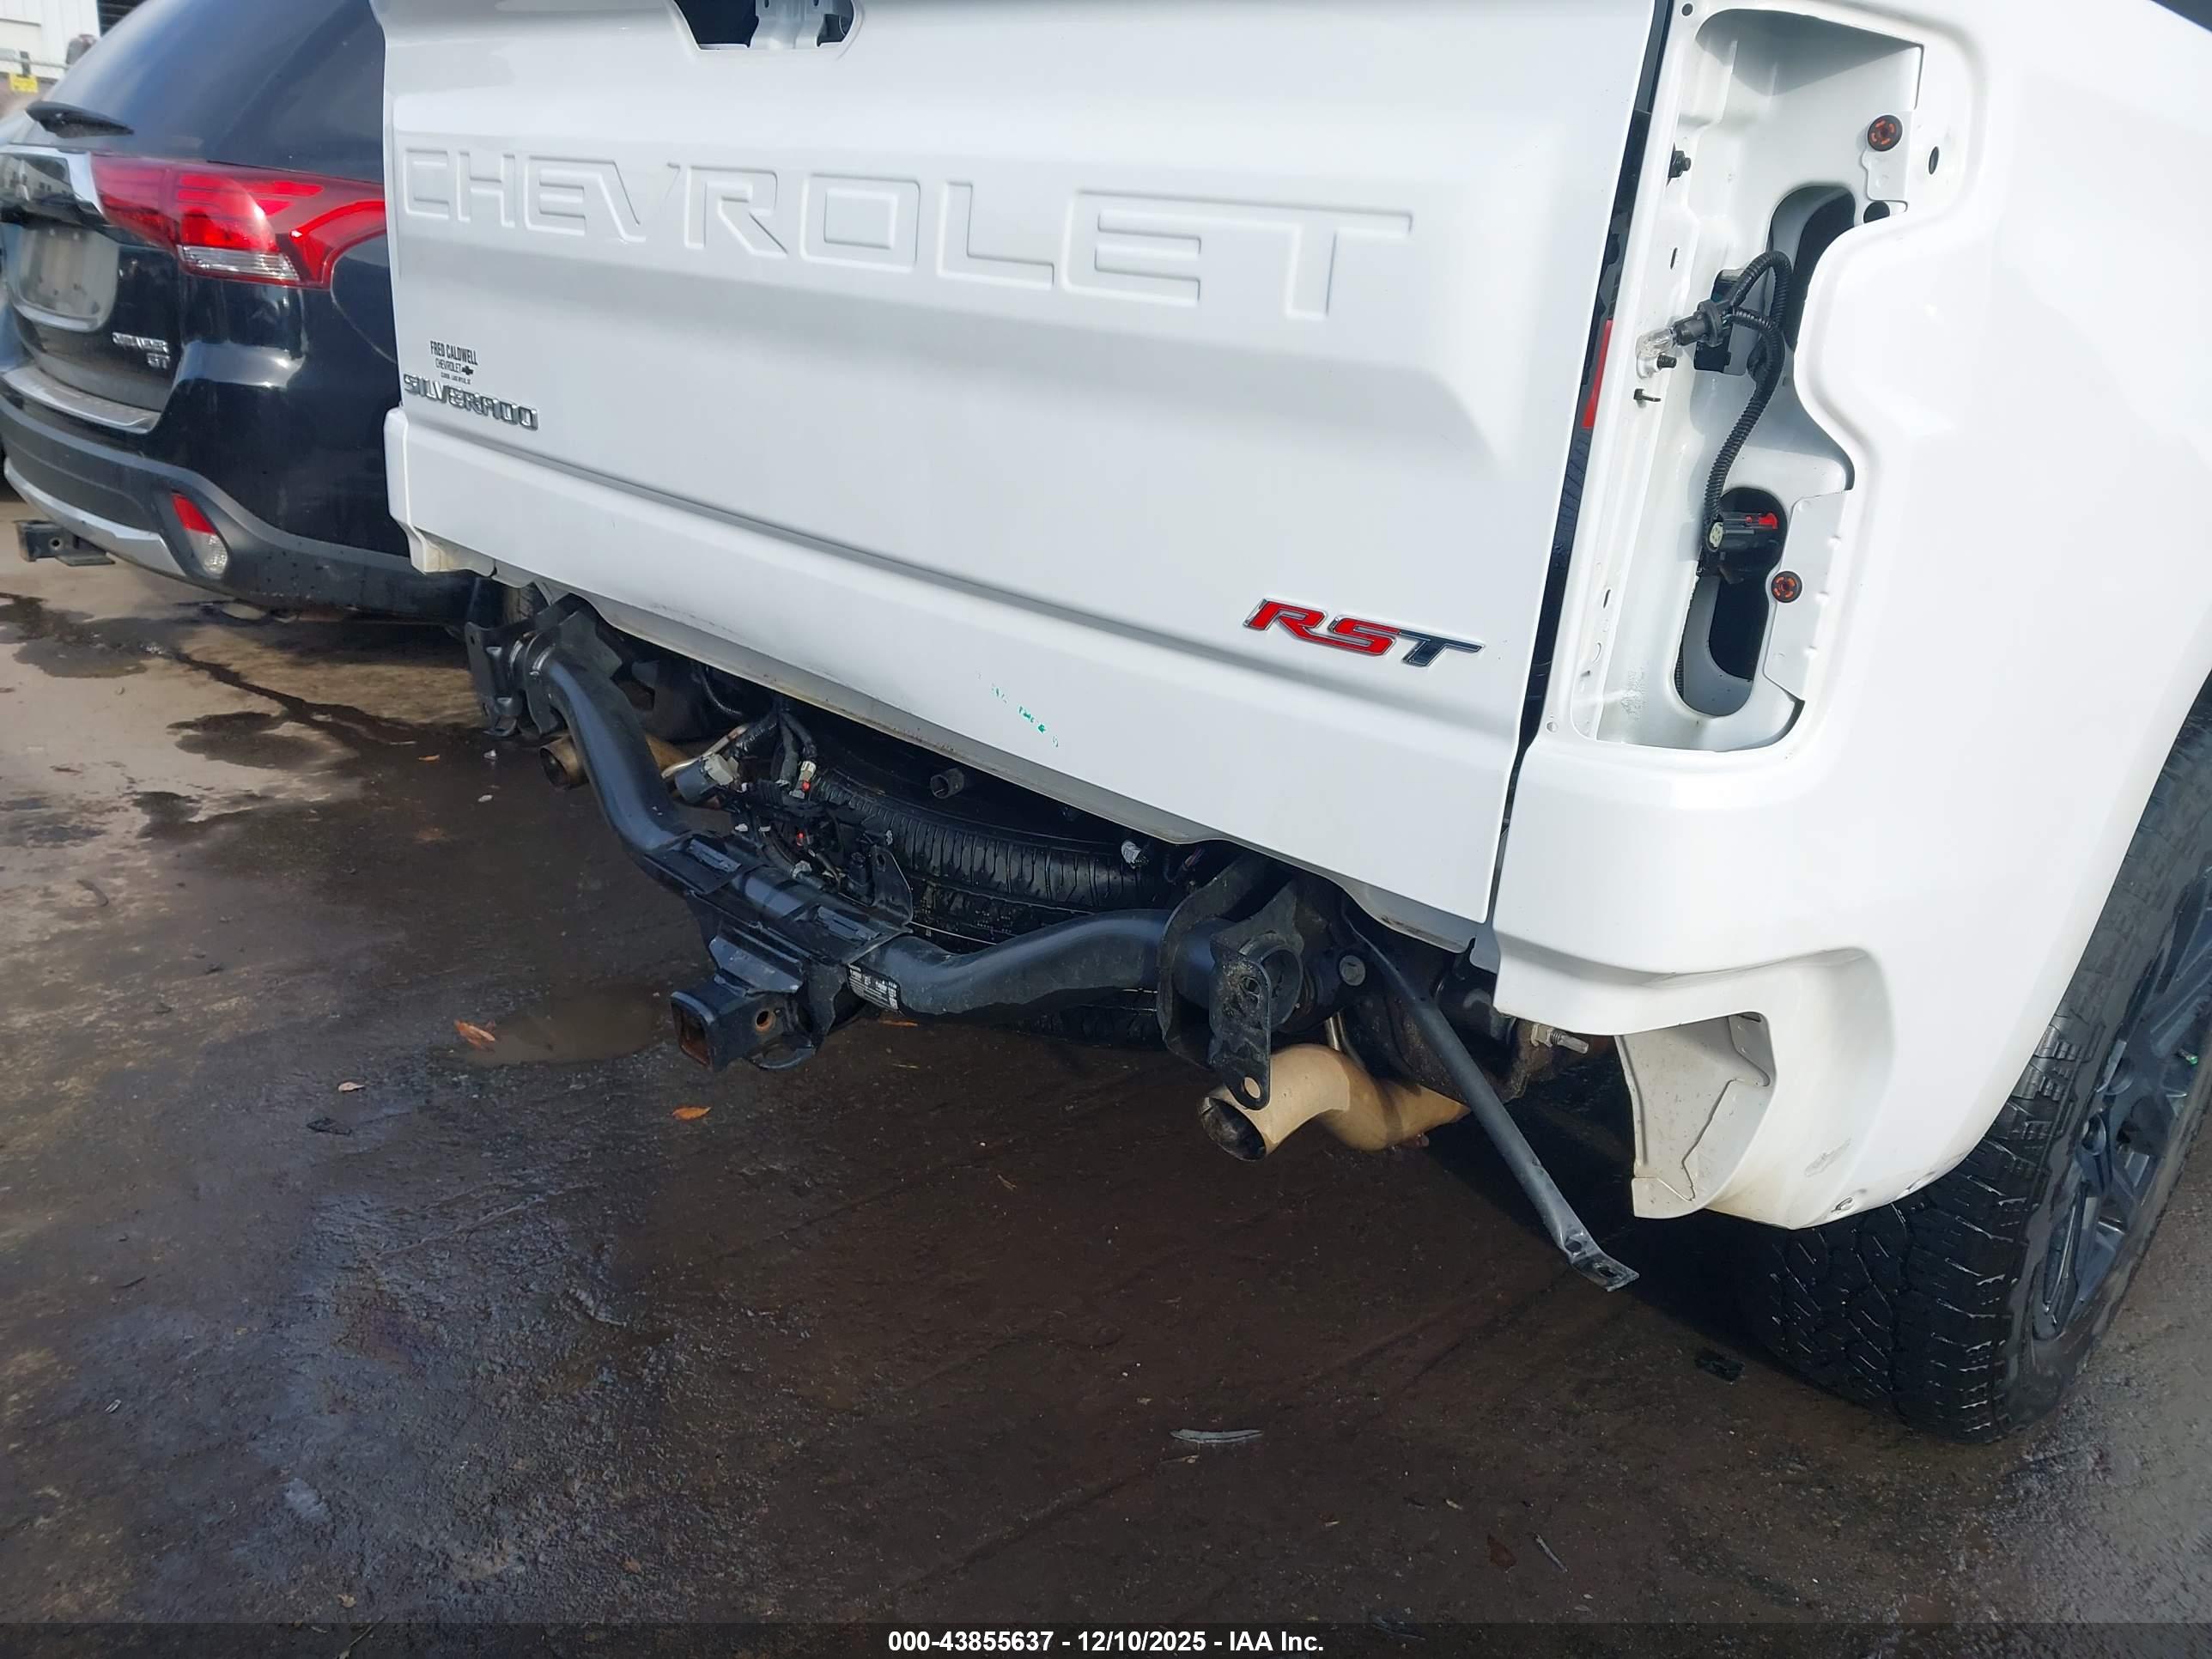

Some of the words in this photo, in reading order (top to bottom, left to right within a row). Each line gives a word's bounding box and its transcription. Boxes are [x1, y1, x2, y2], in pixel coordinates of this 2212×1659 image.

[401, 145, 1413, 321] CHEVROLET
[430, 340, 446, 357] FRED
[446, 343, 478, 366] CALDWELL
[435, 357, 461, 374] CHEVROLET
[404, 373, 538, 432] SILVERADO
[1243, 598, 1486, 668] RST
